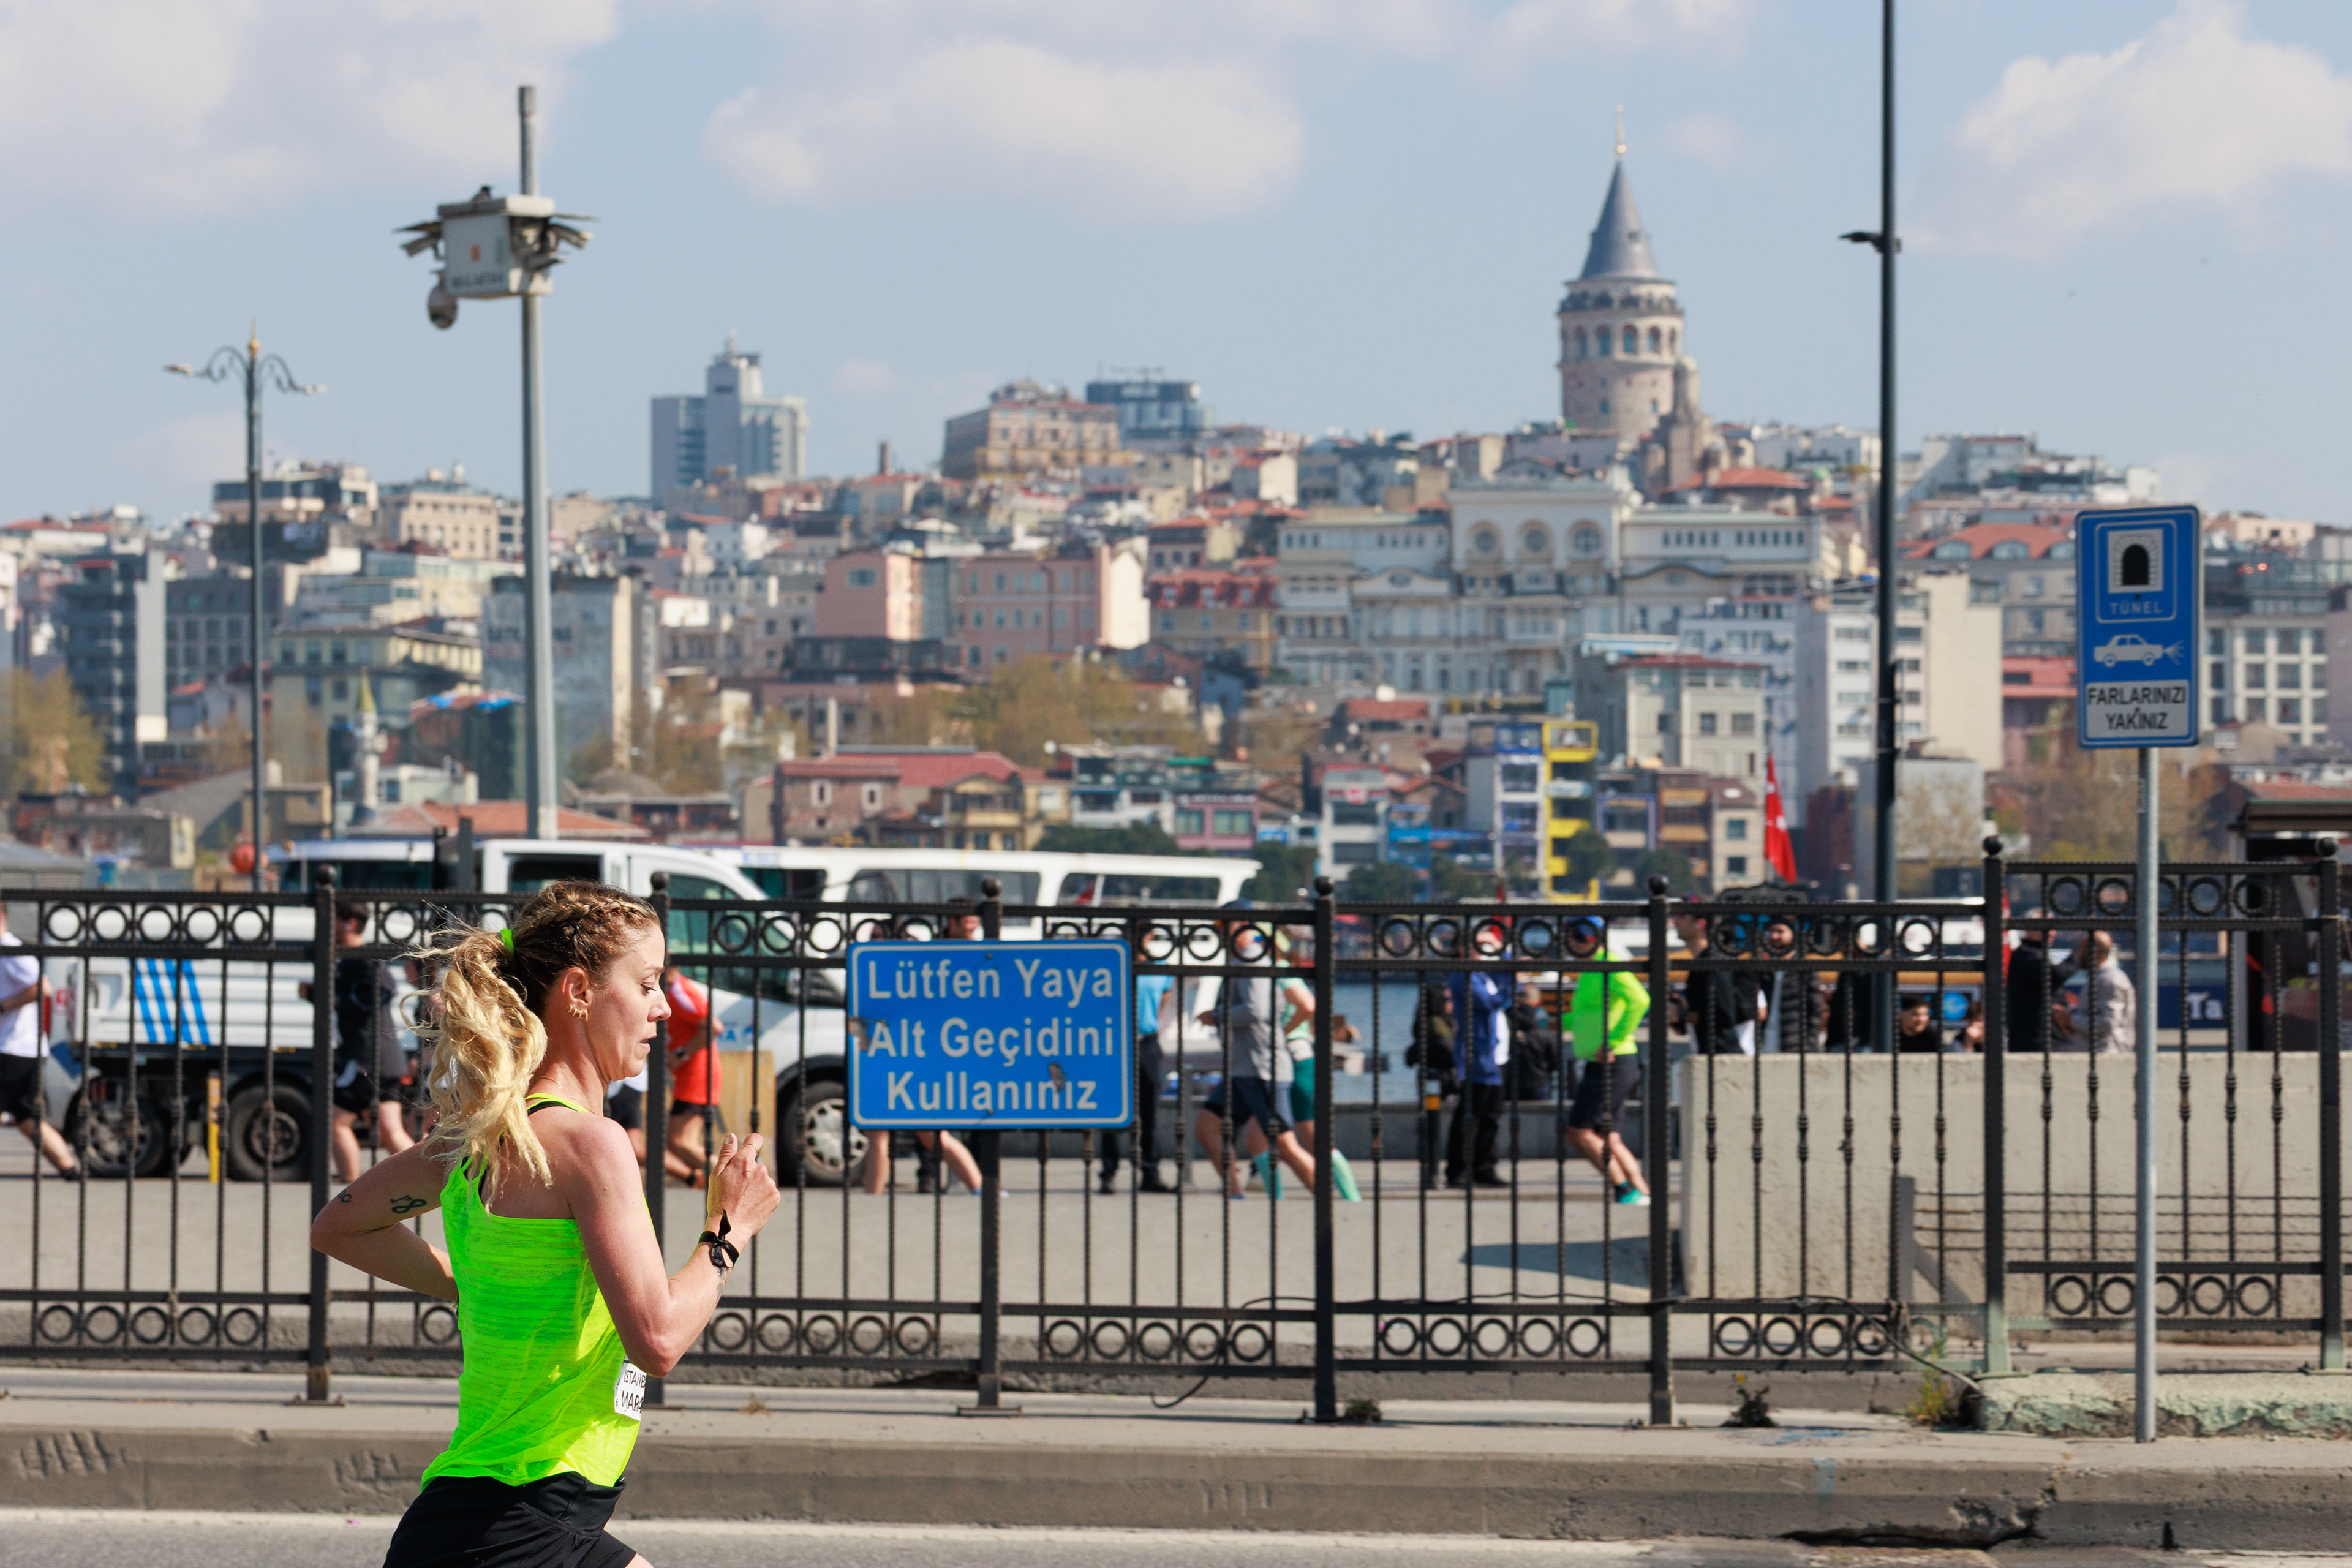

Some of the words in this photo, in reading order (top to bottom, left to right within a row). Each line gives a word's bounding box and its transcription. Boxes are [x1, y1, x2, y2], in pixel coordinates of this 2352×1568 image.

[2110, 601, 2162, 615] TÜNEL
[2087, 686, 2187, 705] FARLARINIZI
[2106, 712, 2168, 730] YAKINIZ
[869, 960, 1000, 999] Lütfen
[1015, 959, 1112, 1008] Yaya
[867, 1019, 925, 1058] Alt
[940, 1017, 1113, 1067] Geçidini
[888, 1071, 1098, 1112] Kullanınız
